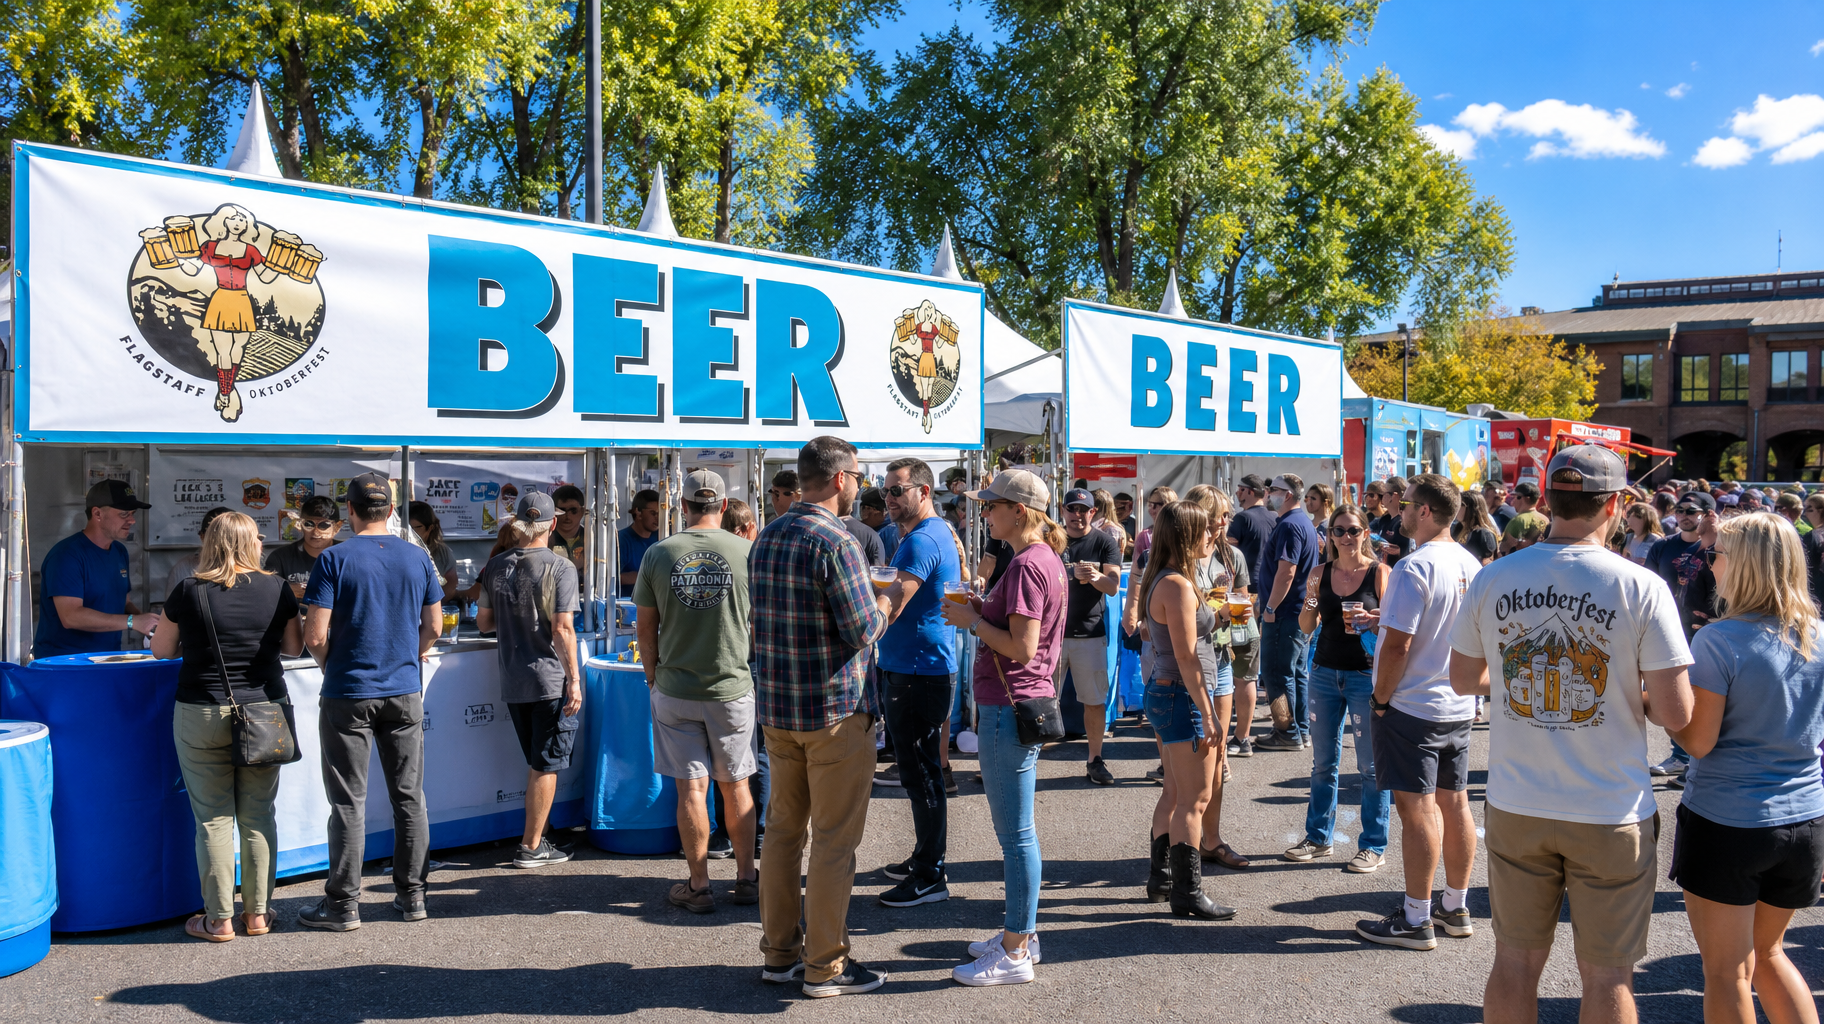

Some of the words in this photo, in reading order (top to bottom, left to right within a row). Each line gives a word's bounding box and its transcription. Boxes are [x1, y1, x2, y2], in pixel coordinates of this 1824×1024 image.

[427, 234, 849, 427] BEER
[119, 335, 206, 397] FLAGSTAFF
[249, 346, 330, 399] OKTOBERFEST
[1130, 334, 1301, 435] BEER
[671, 574, 733, 587] PATAGONIA
[1496, 584, 1617, 631] Oktoberfest
